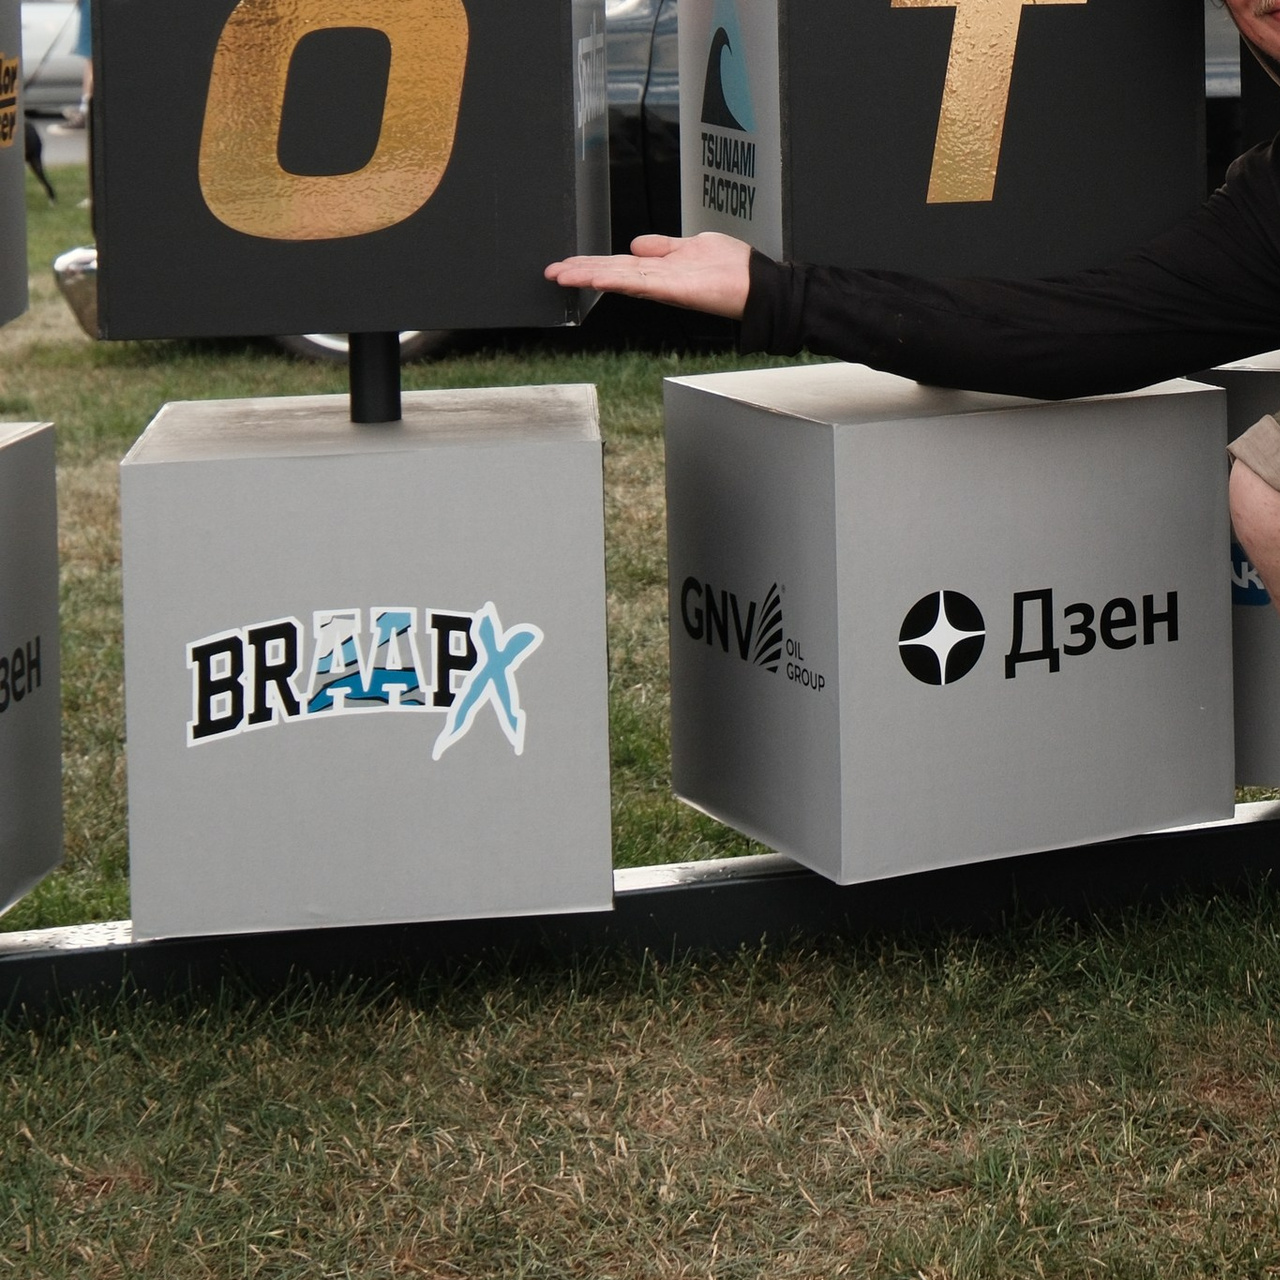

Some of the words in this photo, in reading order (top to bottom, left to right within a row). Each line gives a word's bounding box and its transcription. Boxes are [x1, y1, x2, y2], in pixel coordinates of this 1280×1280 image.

[701, 132, 755, 178] TSUNAMI
[703, 174, 756, 221] FACTORY
[681, 576, 757, 661] GNV
[1004, 587, 1179, 680] Дзен
[786, 638, 804, 661] OIL
[0, 635, 41, 713] зен
[786, 662, 825, 692] GROUP
